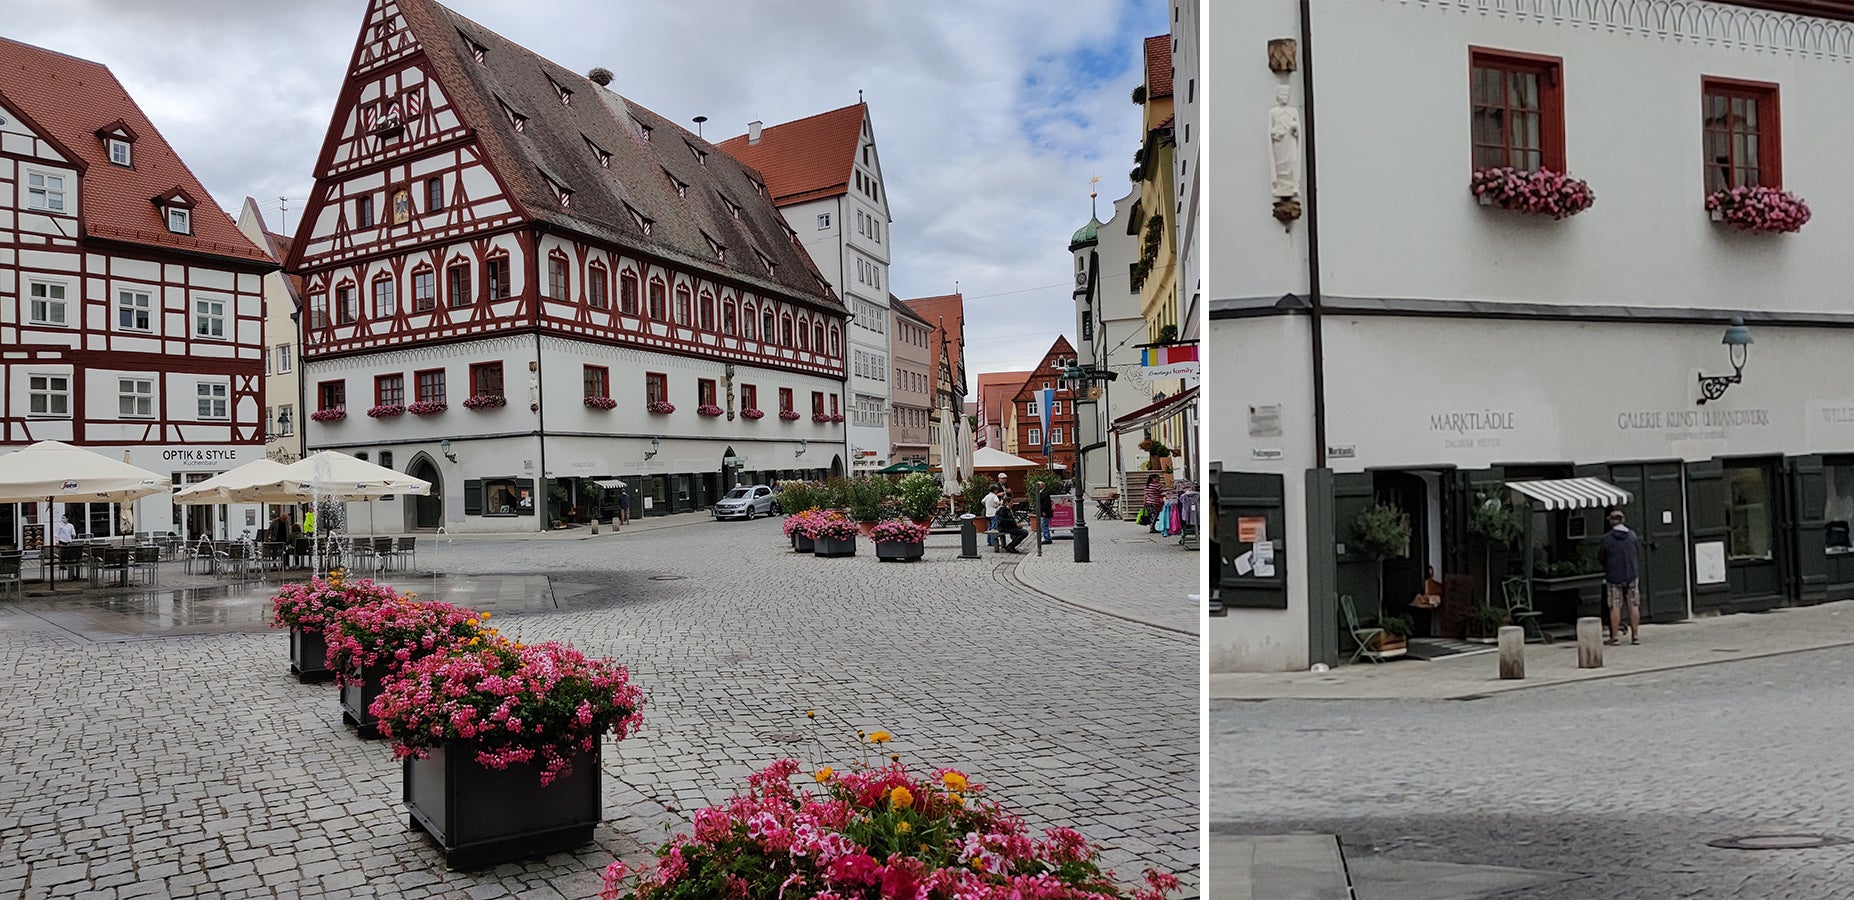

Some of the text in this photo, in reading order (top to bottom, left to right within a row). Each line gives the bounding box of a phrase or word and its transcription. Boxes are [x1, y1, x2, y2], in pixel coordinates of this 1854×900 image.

[1173, 367, 1193, 375] family
[1429, 408, 1515, 435] MARKTLÄDLE
[1617, 411, 1663, 430] GALERIE
[1666, 410, 1698, 428] KUNST
[163, 449, 237, 461] OPTIK & STYLE
